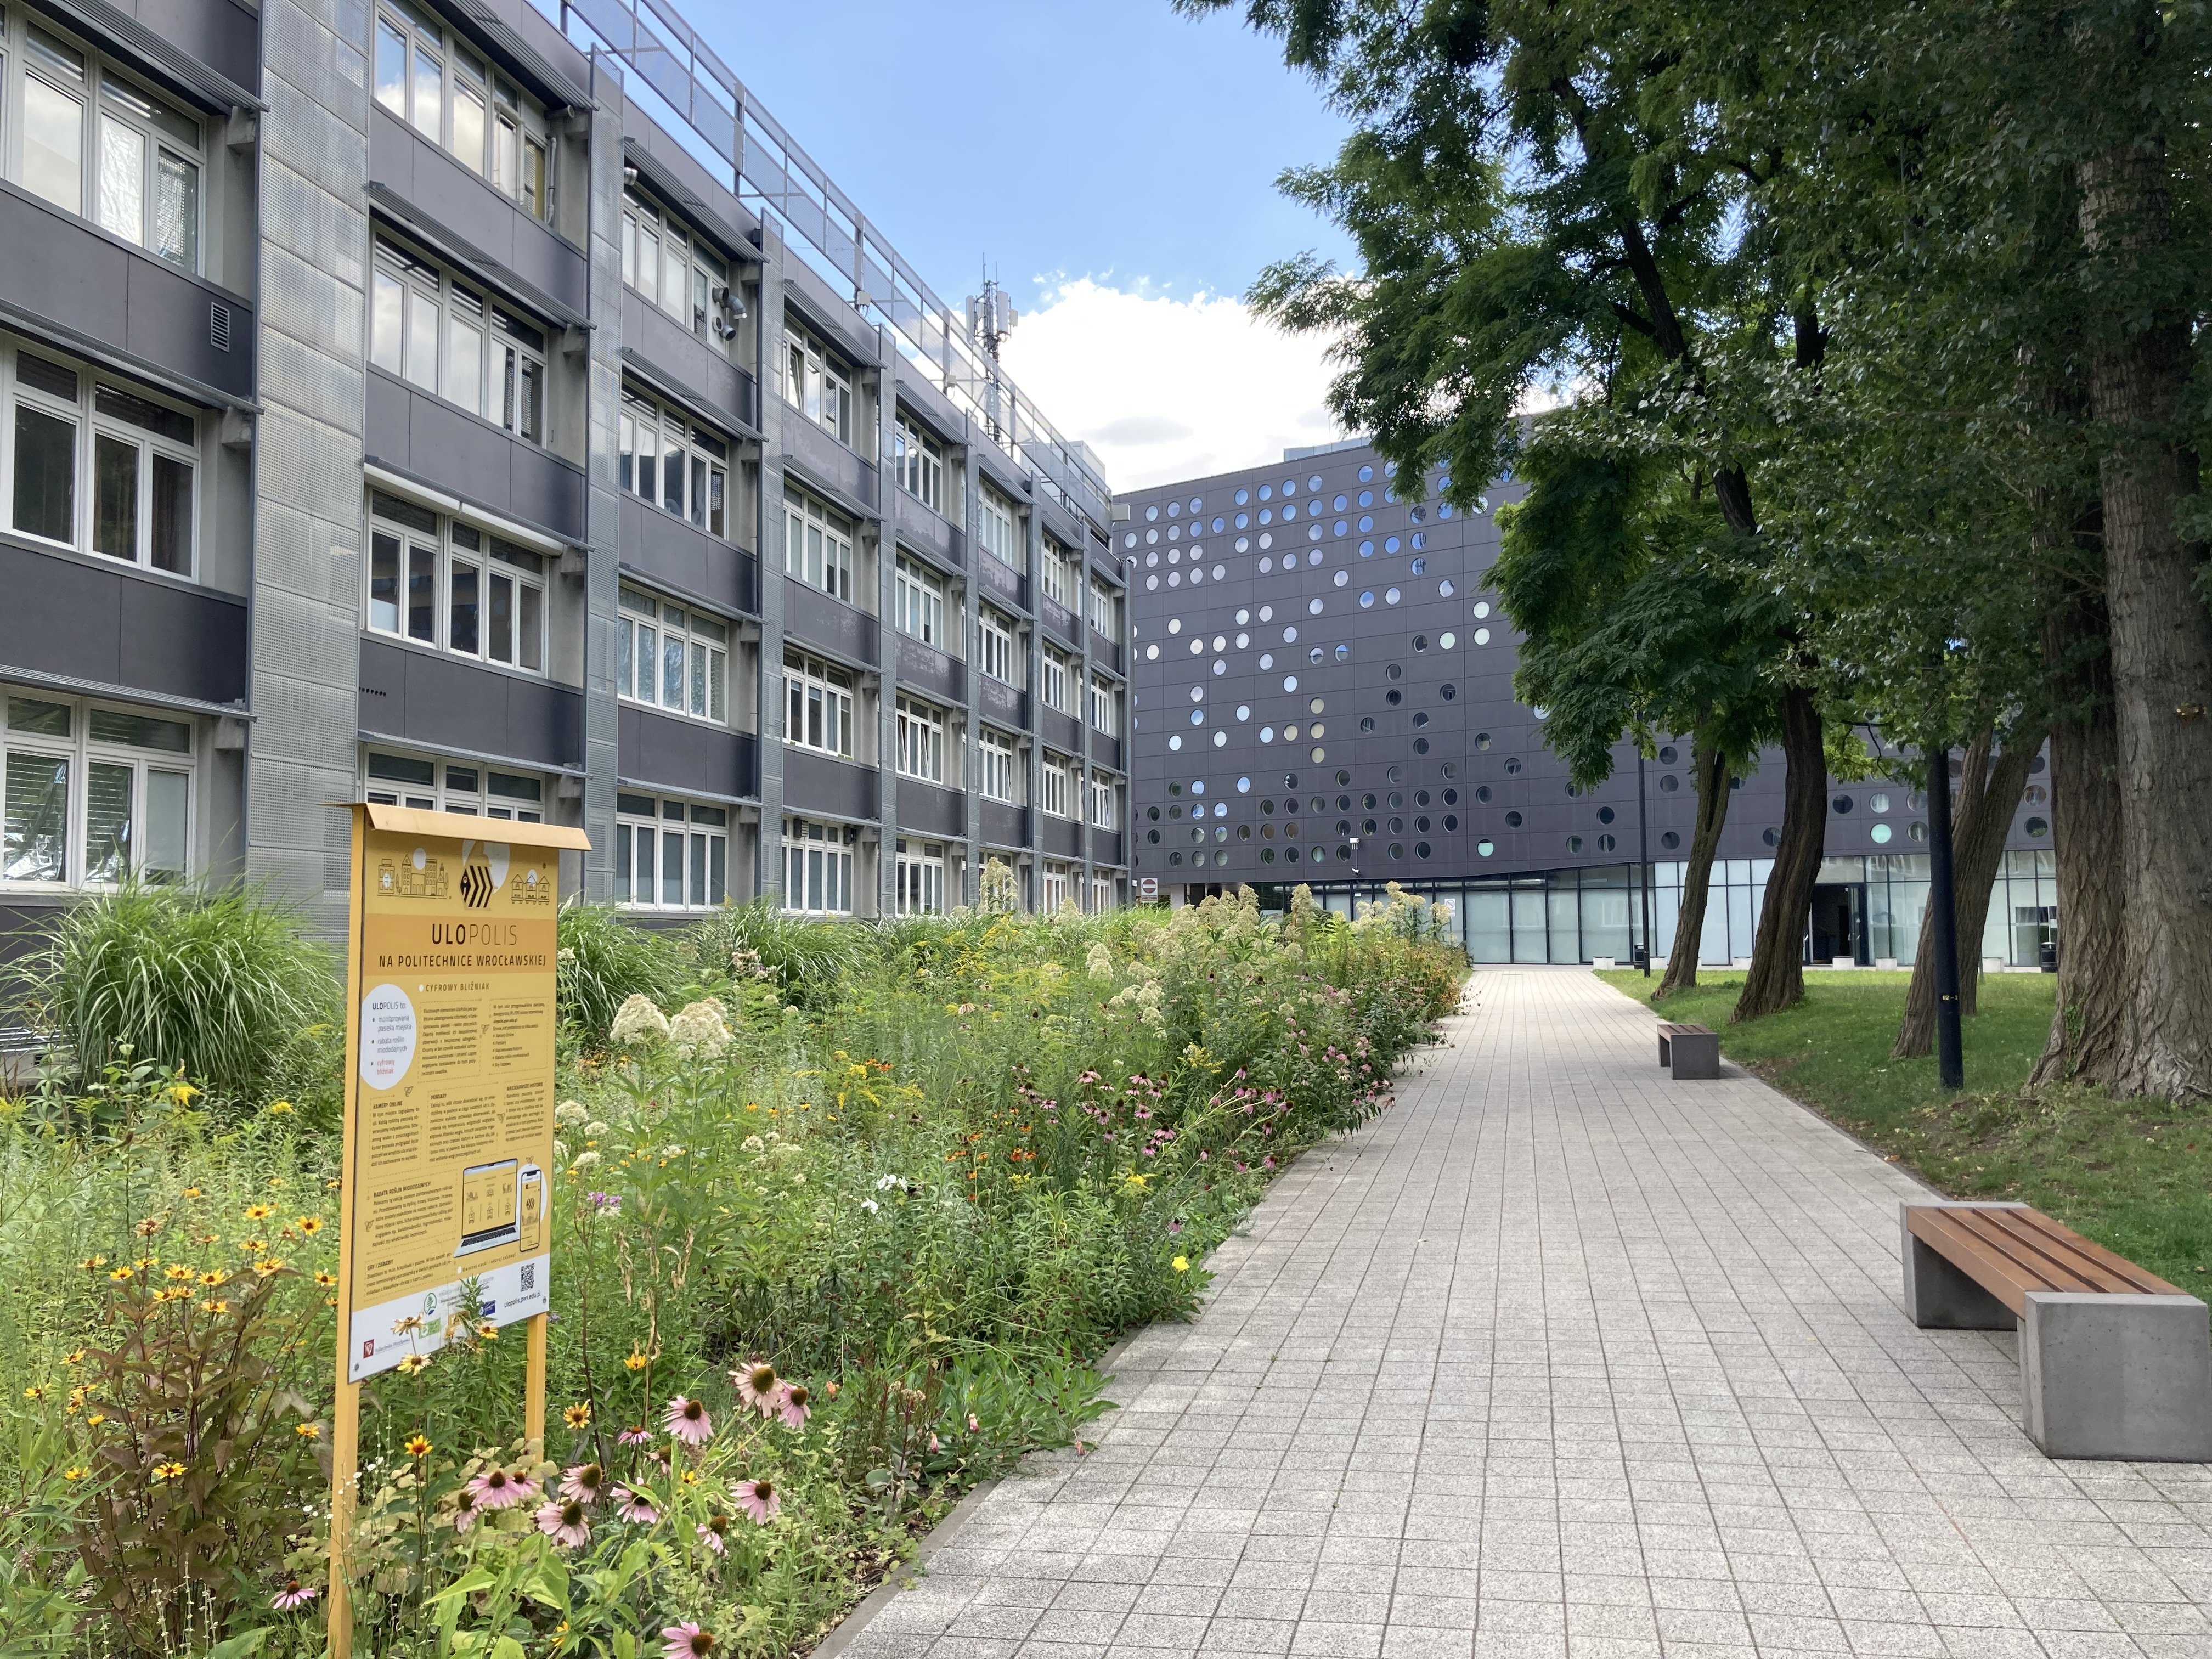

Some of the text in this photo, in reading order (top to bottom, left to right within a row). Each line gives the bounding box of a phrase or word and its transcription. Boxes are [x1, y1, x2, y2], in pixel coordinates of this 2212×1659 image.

[432, 923, 517, 945] ULOPOLIS
[379, 955, 546, 968] NA POLITECHNICE WROCŁAWSKIEJ
[426, 983, 458, 992] CYFROWY
[373, 1002, 399, 1010] ULOPOLIS
